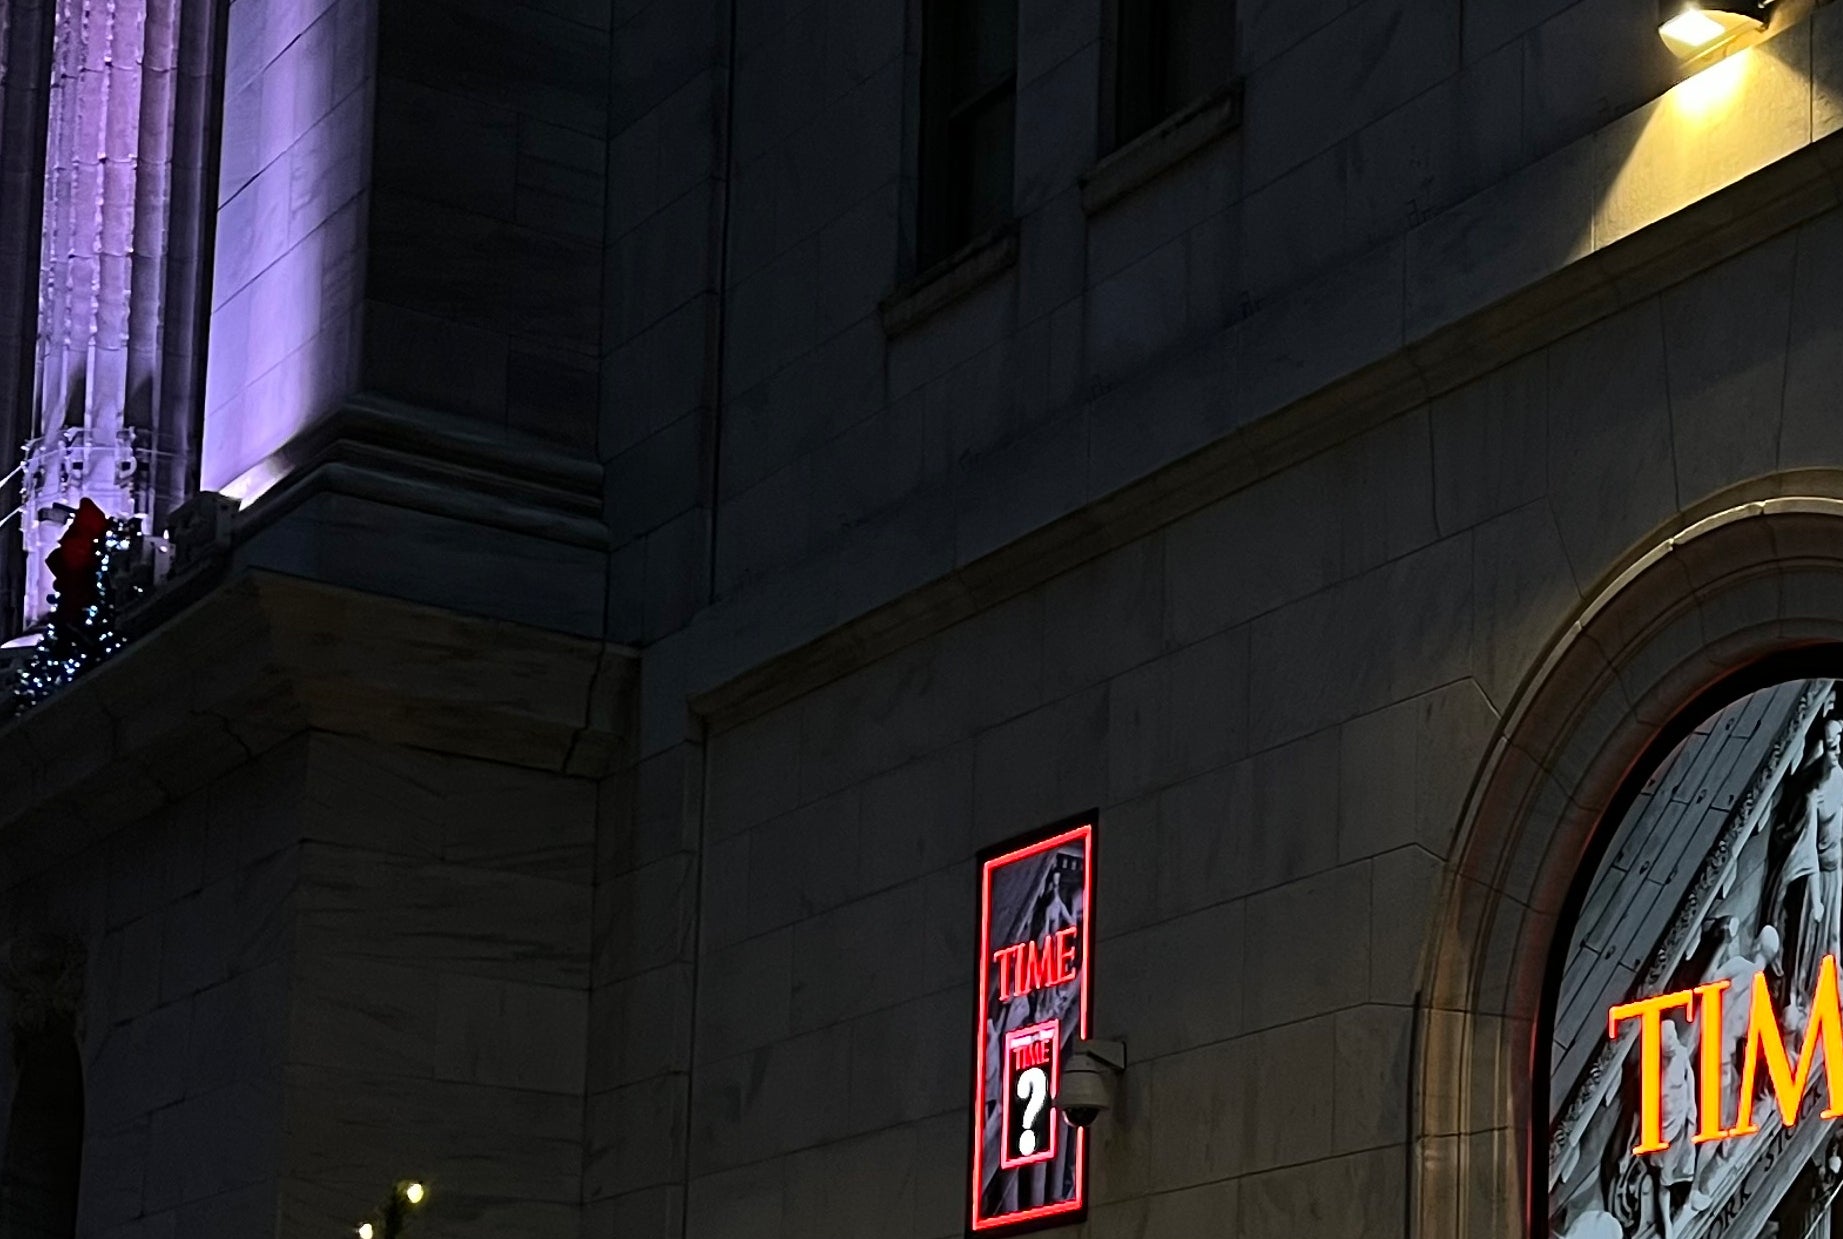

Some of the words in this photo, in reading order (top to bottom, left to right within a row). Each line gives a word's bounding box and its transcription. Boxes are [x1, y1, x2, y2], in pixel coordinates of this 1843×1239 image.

[993, 926, 1077, 1003] TIME
[1013, 1038, 1050, 1071] TIME
[1016, 1067, 1048, 1157] ?
